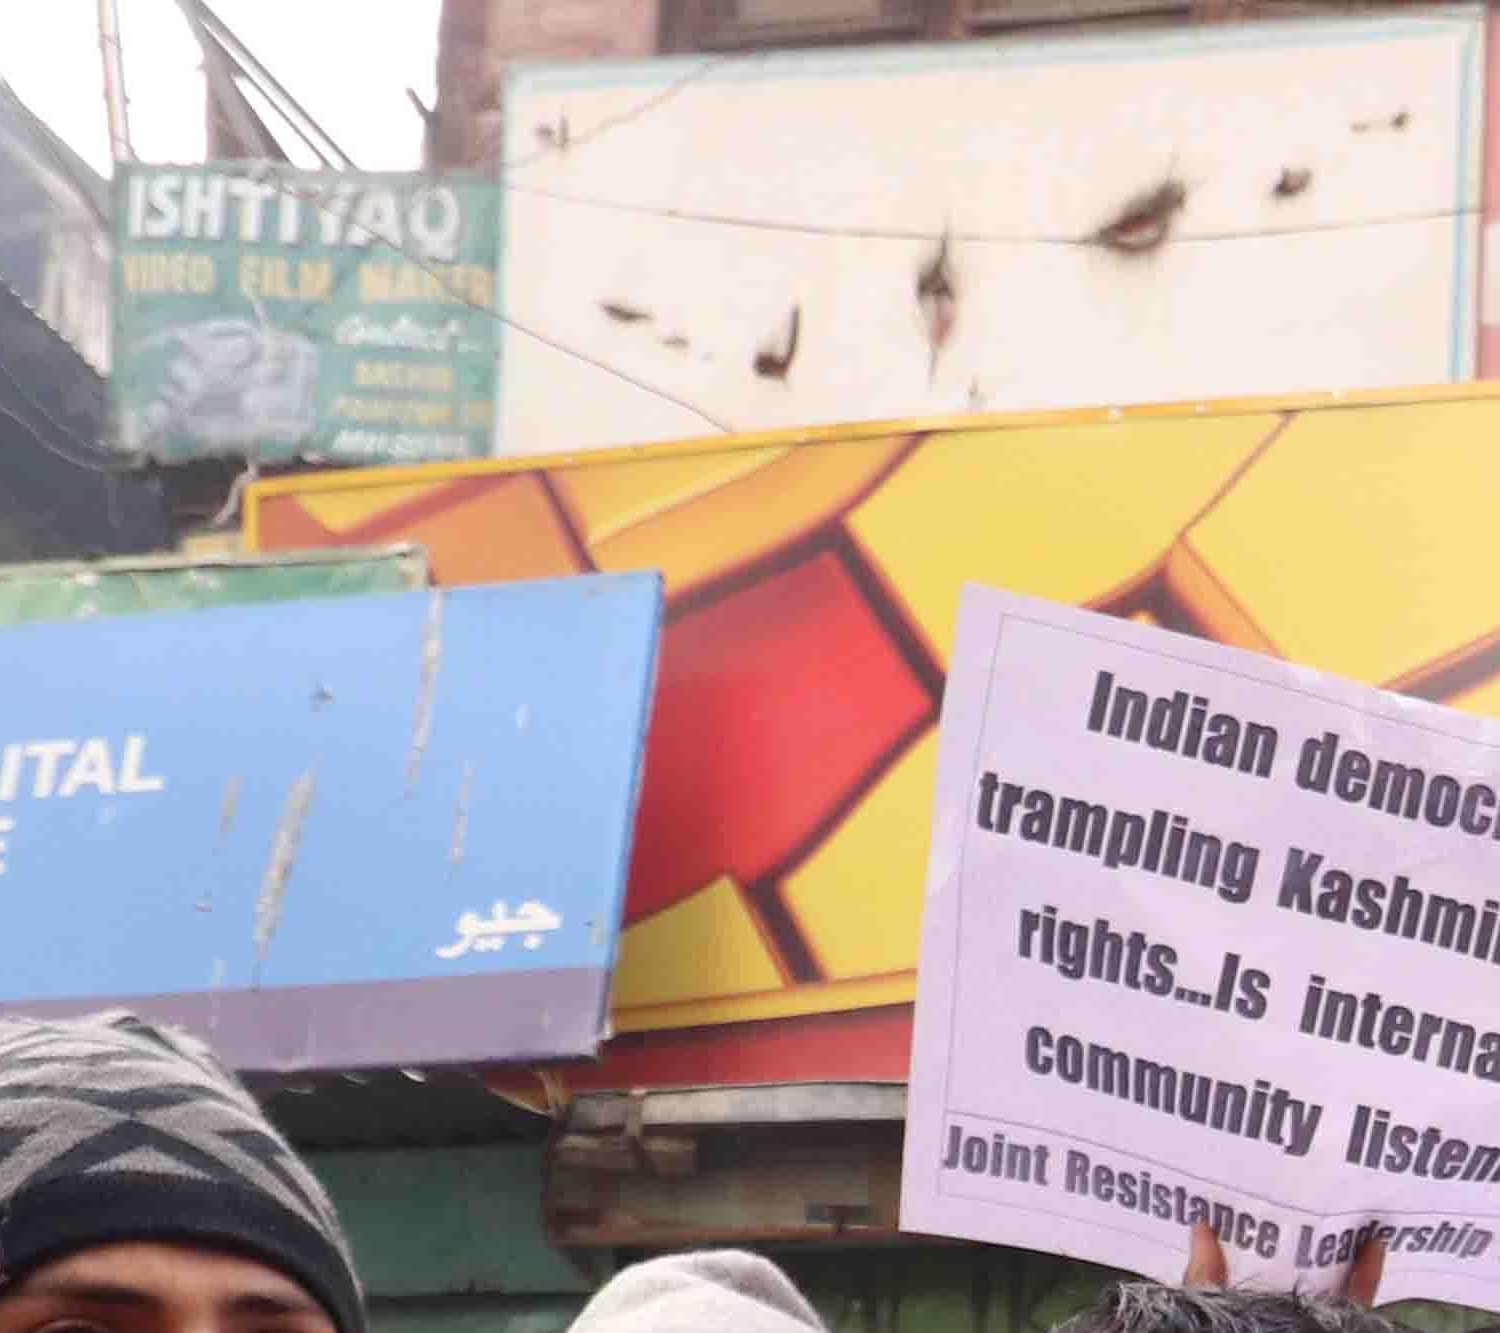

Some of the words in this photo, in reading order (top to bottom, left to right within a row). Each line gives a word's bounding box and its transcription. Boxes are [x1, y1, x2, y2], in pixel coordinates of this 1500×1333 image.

[1087, 671, 1279, 779] Indian
[975, 771, 1260, 904] trampling
[1024, 1025, 1323, 1157] community
[943, 1125, 1050, 1185] Joint
[1064, 1149, 1281, 1259] Resistance
[1294, 1219, 1493, 1270] Leadership
